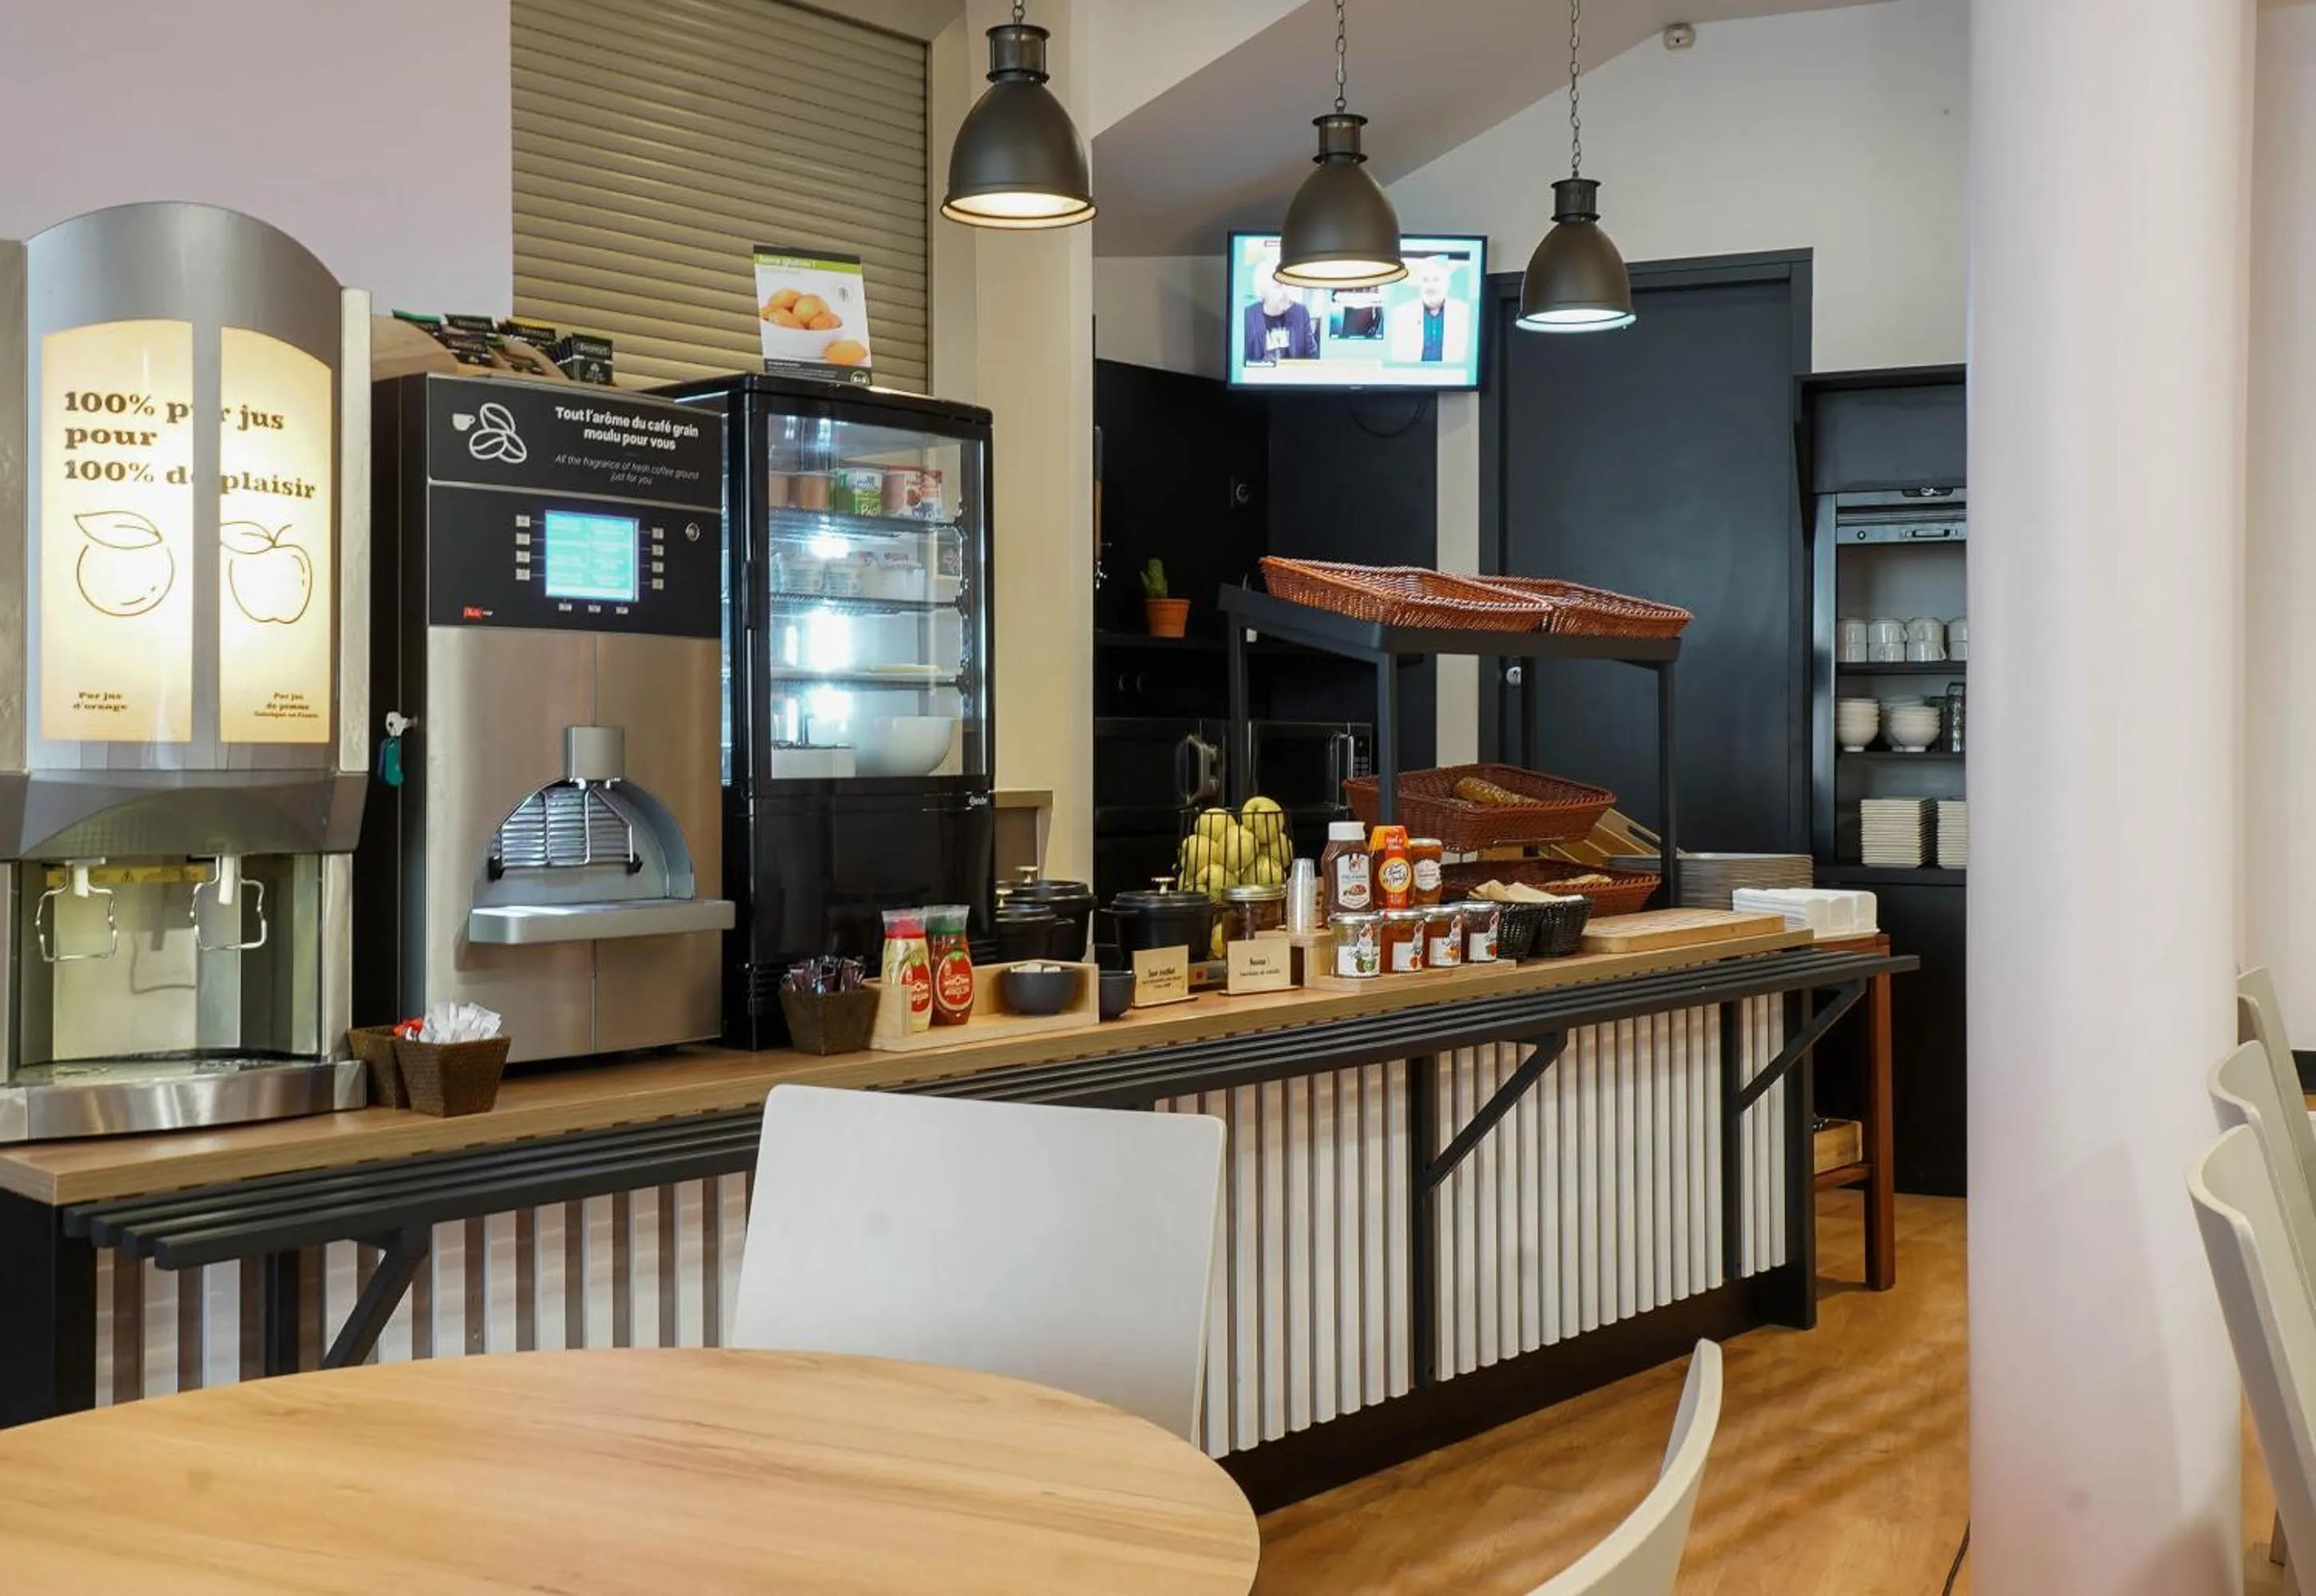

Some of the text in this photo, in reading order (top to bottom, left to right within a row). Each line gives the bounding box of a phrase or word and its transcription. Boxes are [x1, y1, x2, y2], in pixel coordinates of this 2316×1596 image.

[65, 391, 284, 430] 100% pr jus
[555, 406, 699, 438] Tout l'arôme du café grain
[65, 427, 157, 449] pour
[583, 428, 676, 451] moulu pour vous
[65, 460, 315, 499] 100% d plaisir
